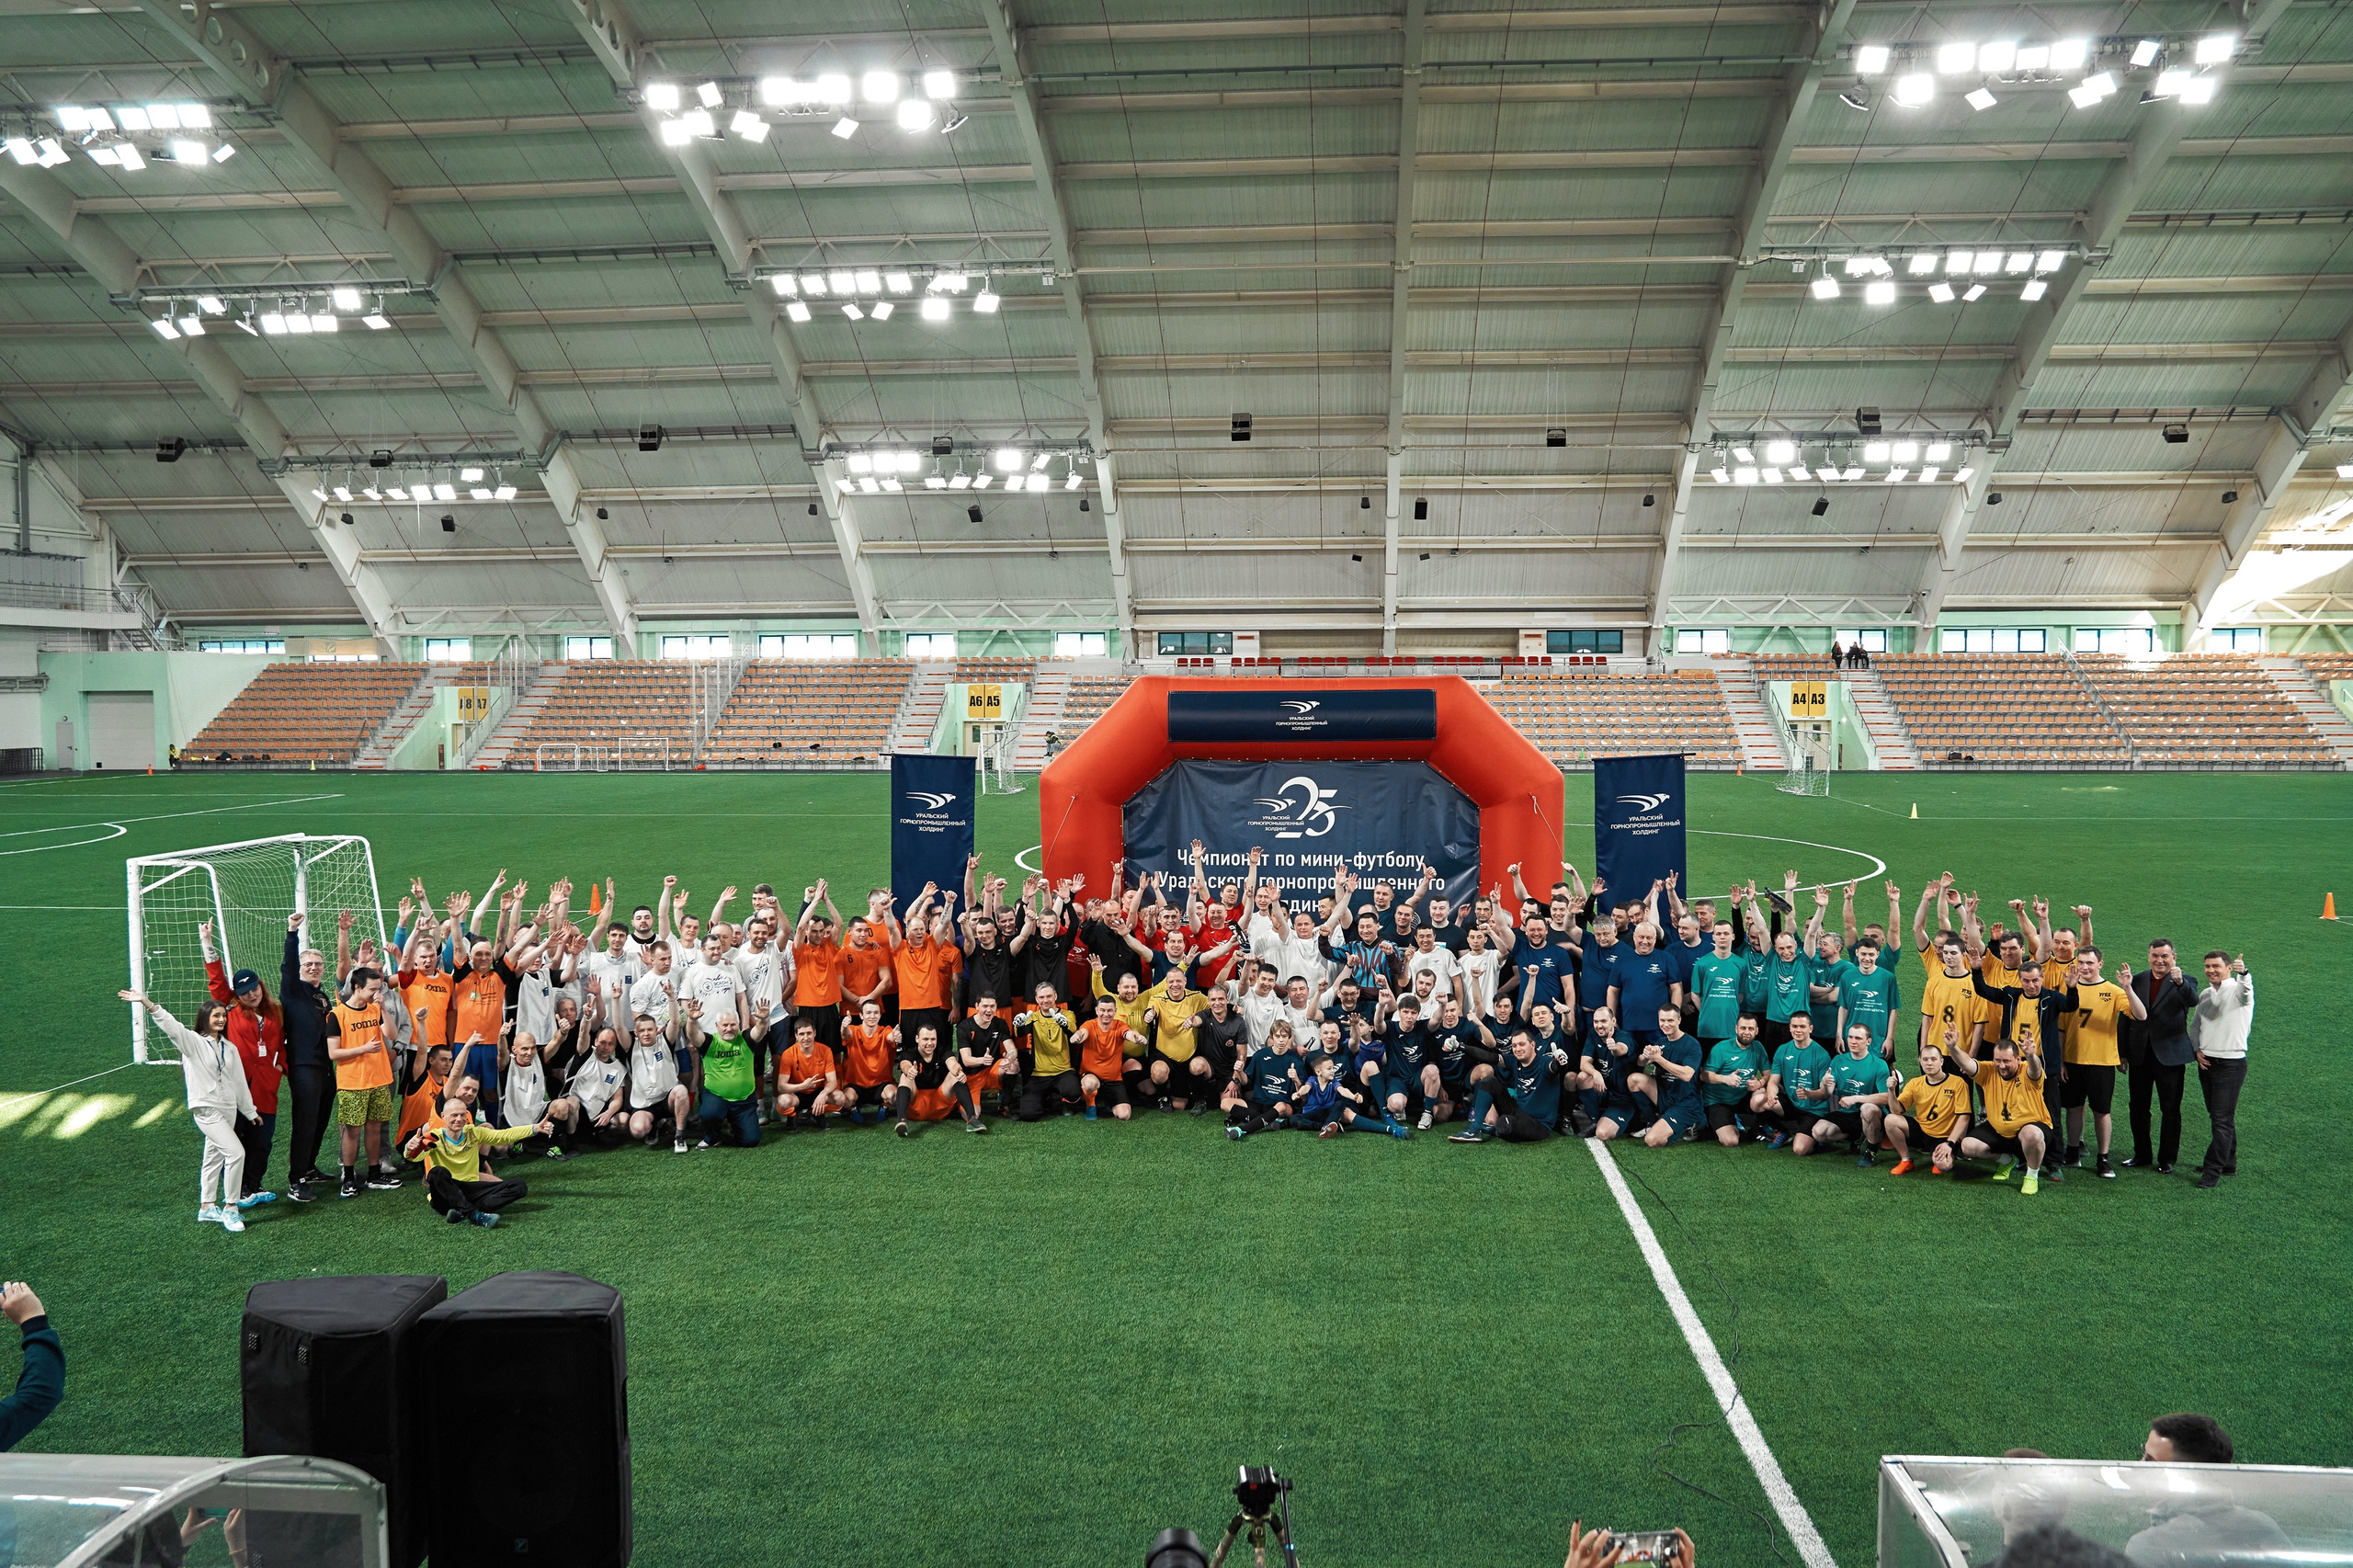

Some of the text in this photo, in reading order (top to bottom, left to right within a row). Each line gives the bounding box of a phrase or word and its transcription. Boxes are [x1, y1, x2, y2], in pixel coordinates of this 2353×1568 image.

[970, 695, 983, 707] A6
[986, 695, 1000, 707] A5
[1792, 693, 1806, 704] A4
[1811, 693, 1824, 704] A3
[900, 818, 966, 826] ГОРНОПРОМЫШЛЕННЫЙ
[1629, 813, 1663, 822] УРАЛЬСКИЙ
[1610, 819, 1681, 829] ГОРНОПРОМЫШЛЕННЫЙ
[1177, 848, 1425, 872] Чемпионт по мини-футболу
[1158, 870, 1248, 892] Уралског
[847, 954, 853, 963] 6
[1943, 1005, 1954, 1023] 8
[2079, 1007, 2093, 1028] 7
[1927, 1104, 1938, 1121] 6
